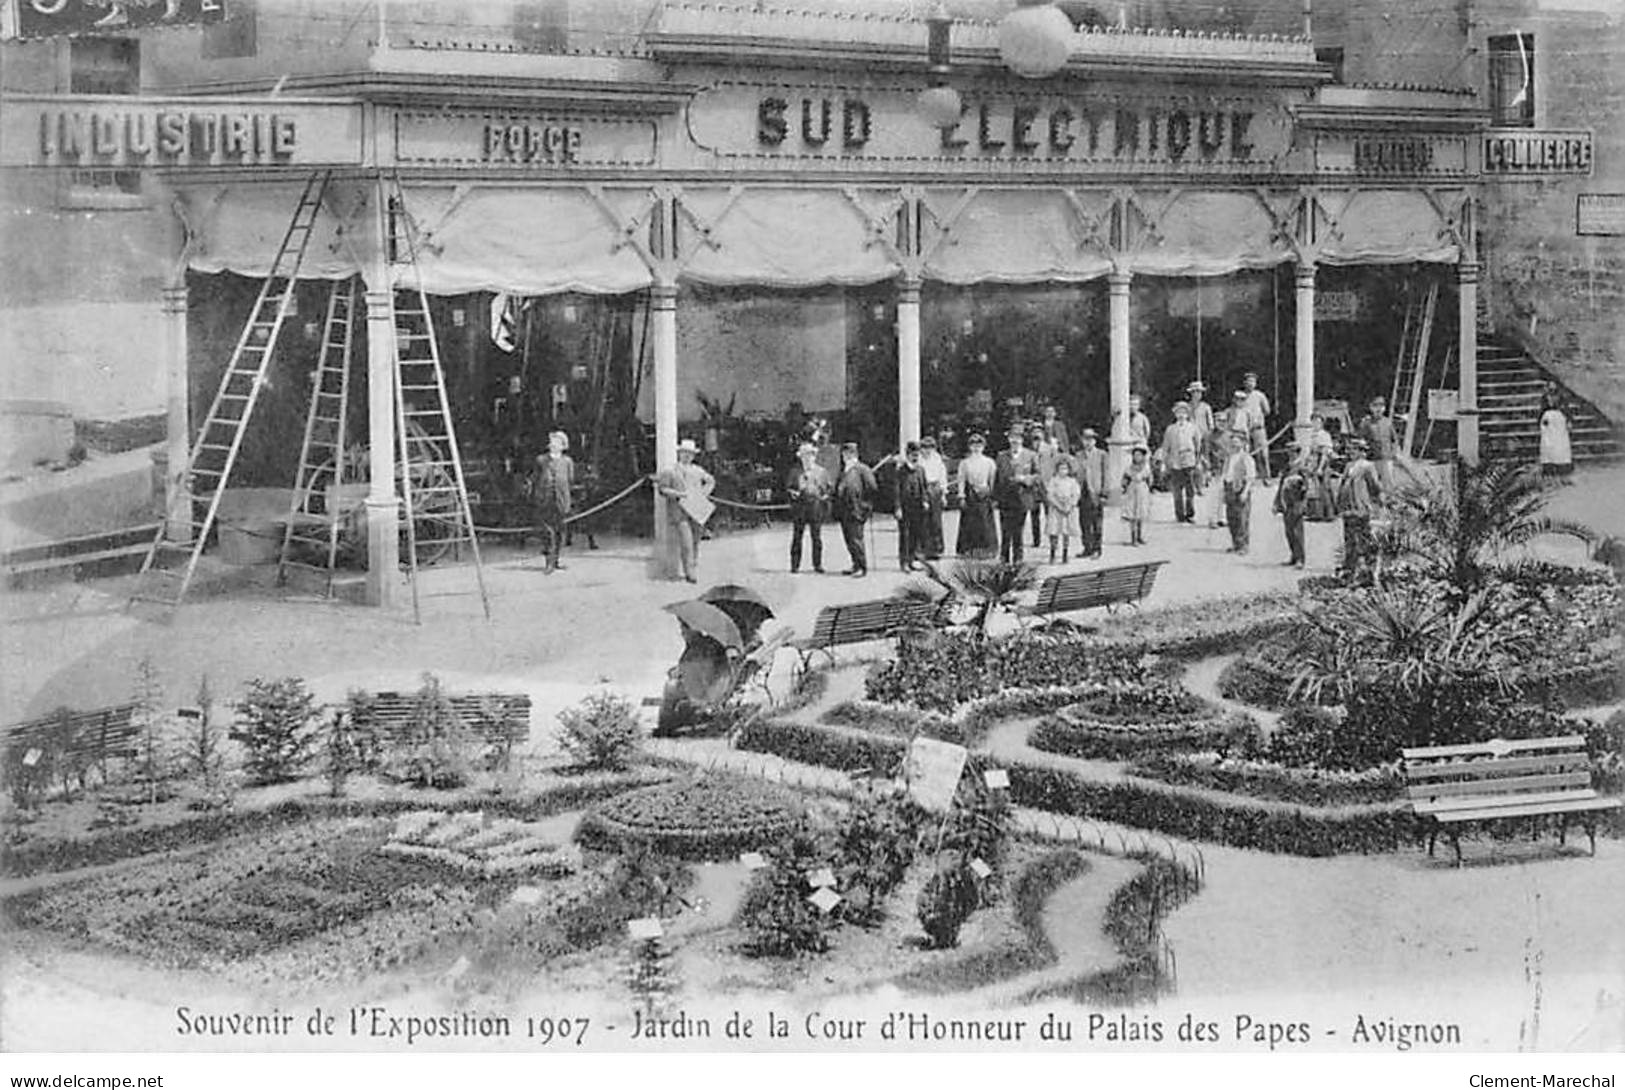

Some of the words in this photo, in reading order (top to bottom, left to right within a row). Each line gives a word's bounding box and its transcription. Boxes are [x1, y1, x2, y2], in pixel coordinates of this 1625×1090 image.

[39, 110, 297, 155] INDUSTRIE
[483, 125, 581, 156] FORCE
[758, 97, 872, 150] SUD
[1485, 138, 1591, 169] COMMERCE
